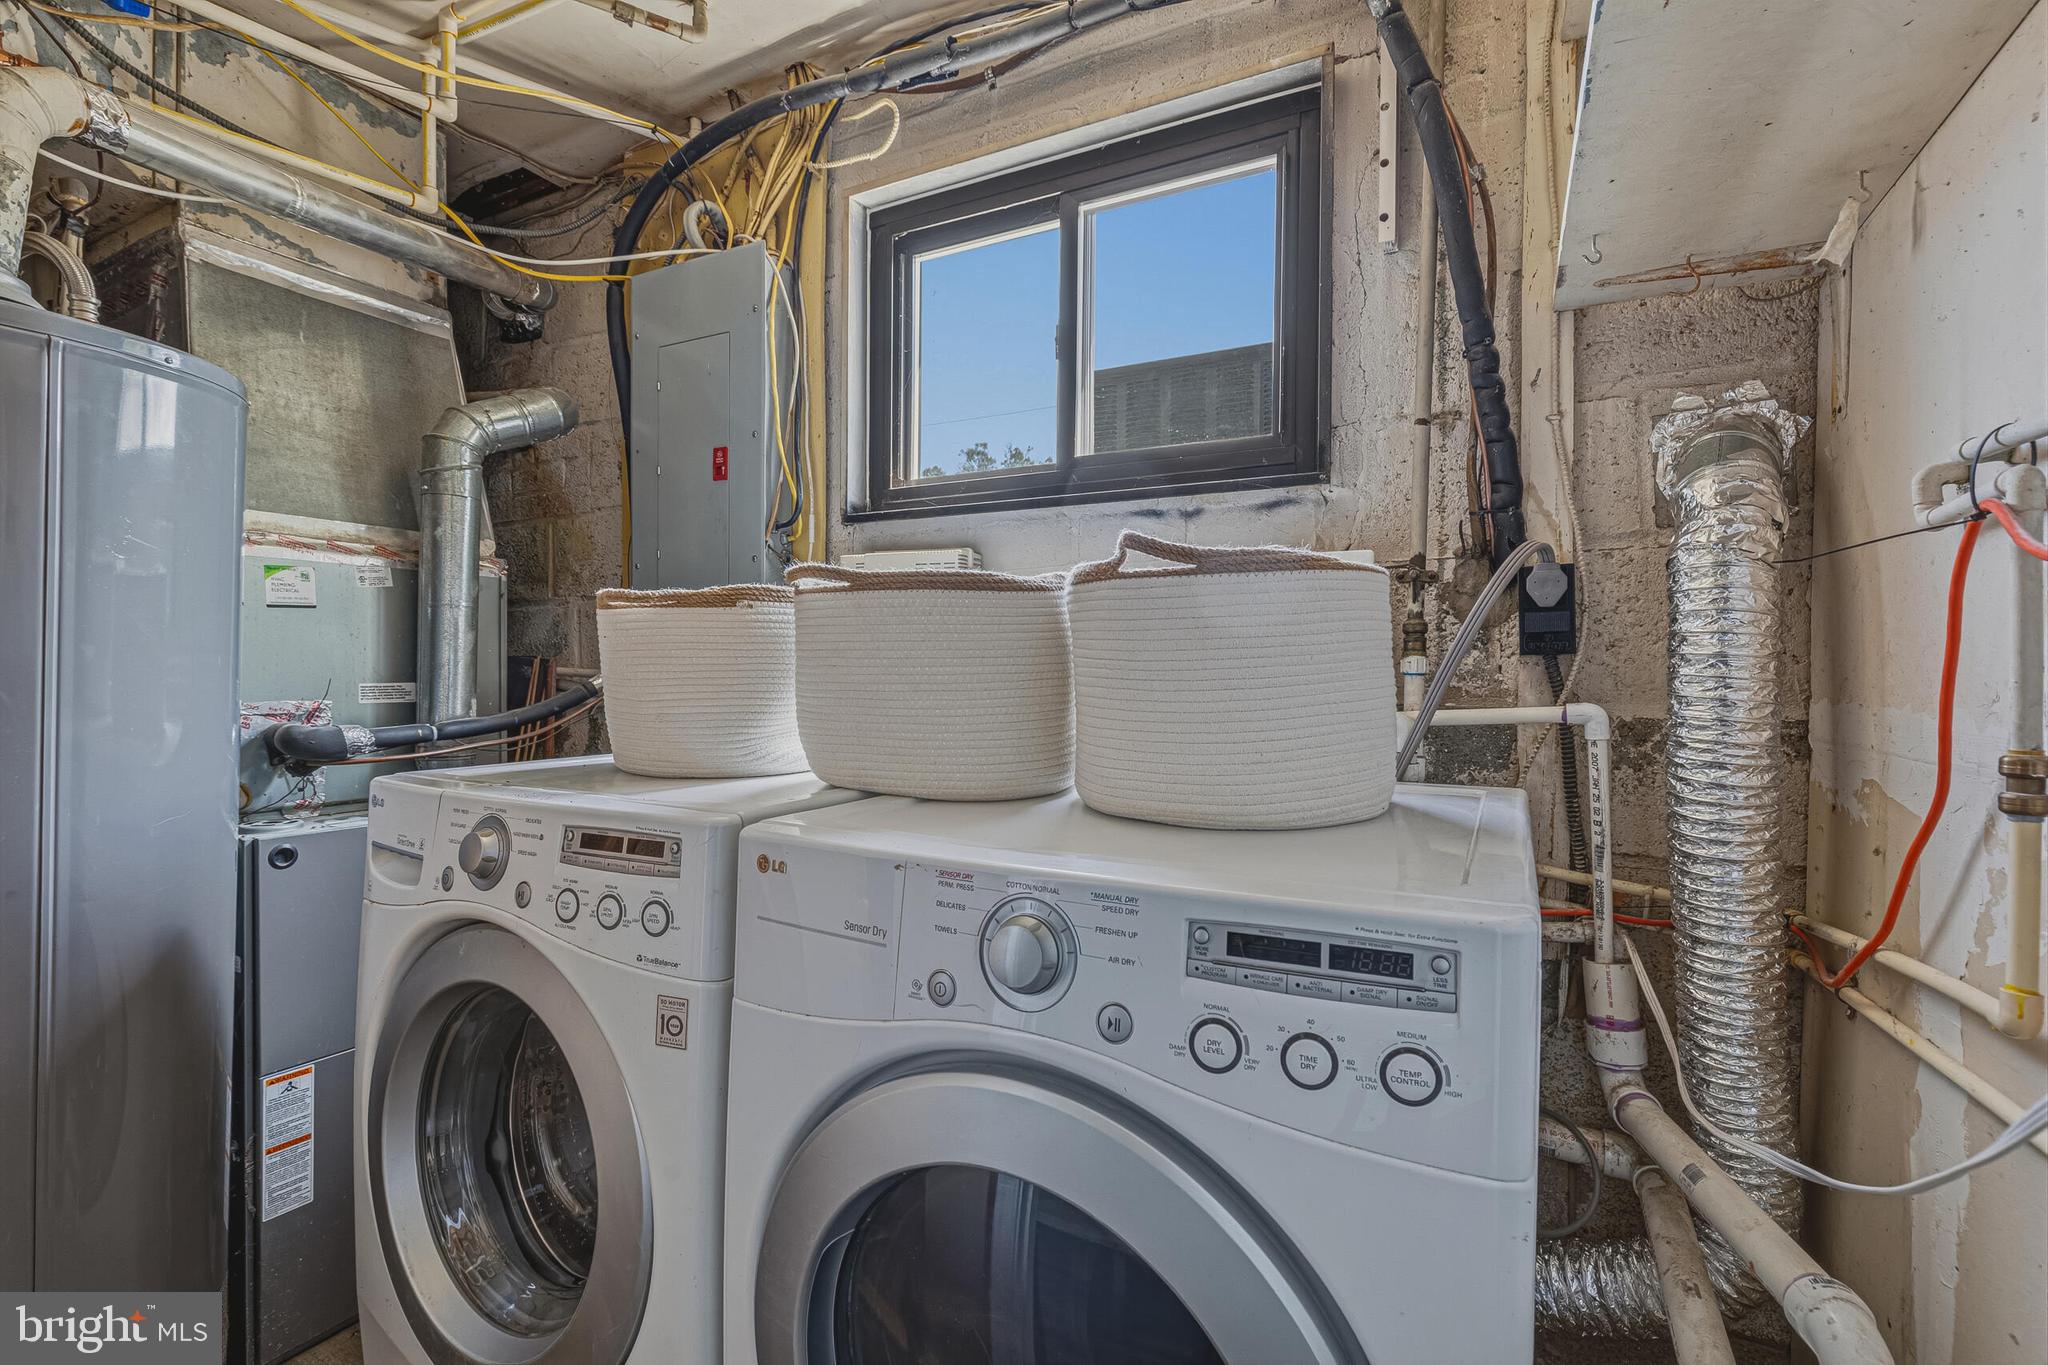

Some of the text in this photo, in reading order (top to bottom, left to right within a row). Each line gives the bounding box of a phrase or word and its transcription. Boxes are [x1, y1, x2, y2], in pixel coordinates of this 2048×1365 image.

[1591, 752, 1599, 771] 2007
[1592, 794, 1600, 803] 25
[1593, 807, 1600, 817] 02
[939, 870, 974, 881] SENSOR DRY
[956, 883, 974, 891] PRESS
[935, 900, 966, 911] DELICATES
[1124, 896, 1140, 904] DRY
[1101, 904, 1140, 916] SPEED DRY
[843, 920, 888, 940] Sensor Dry
[934, 924, 958, 935] TOWELS
[1095, 926, 1138, 939] FRESHEN UP
[1107, 956, 1136, 967] AIR DRY
[1203, 1002, 1231, 1013] NORMAL
[660, 1013, 684, 1038] 10
[1306, 1018, 1316, 1026] 40
[1336, 1034, 1346, 1043] 50
[1396, 1030, 1428, 1041] MEDIUM
[1206, 1038, 1222, 1047] DRY
[1266, 1044, 1274, 1052] 20
[1202, 1045, 1225, 1056] LEVEL
[1299, 1054, 1319, 1065] TIME
[1243, 1064, 1257, 1072] DRY
[1300, 1062, 1317, 1071] DRY
[1355, 1075, 1378, 1084] ULTRA
[1390, 1075, 1432, 1089] CONTROL
[1361, 1083, 1378, 1092] LOW
[1443, 1090, 1464, 1099] HIGH
